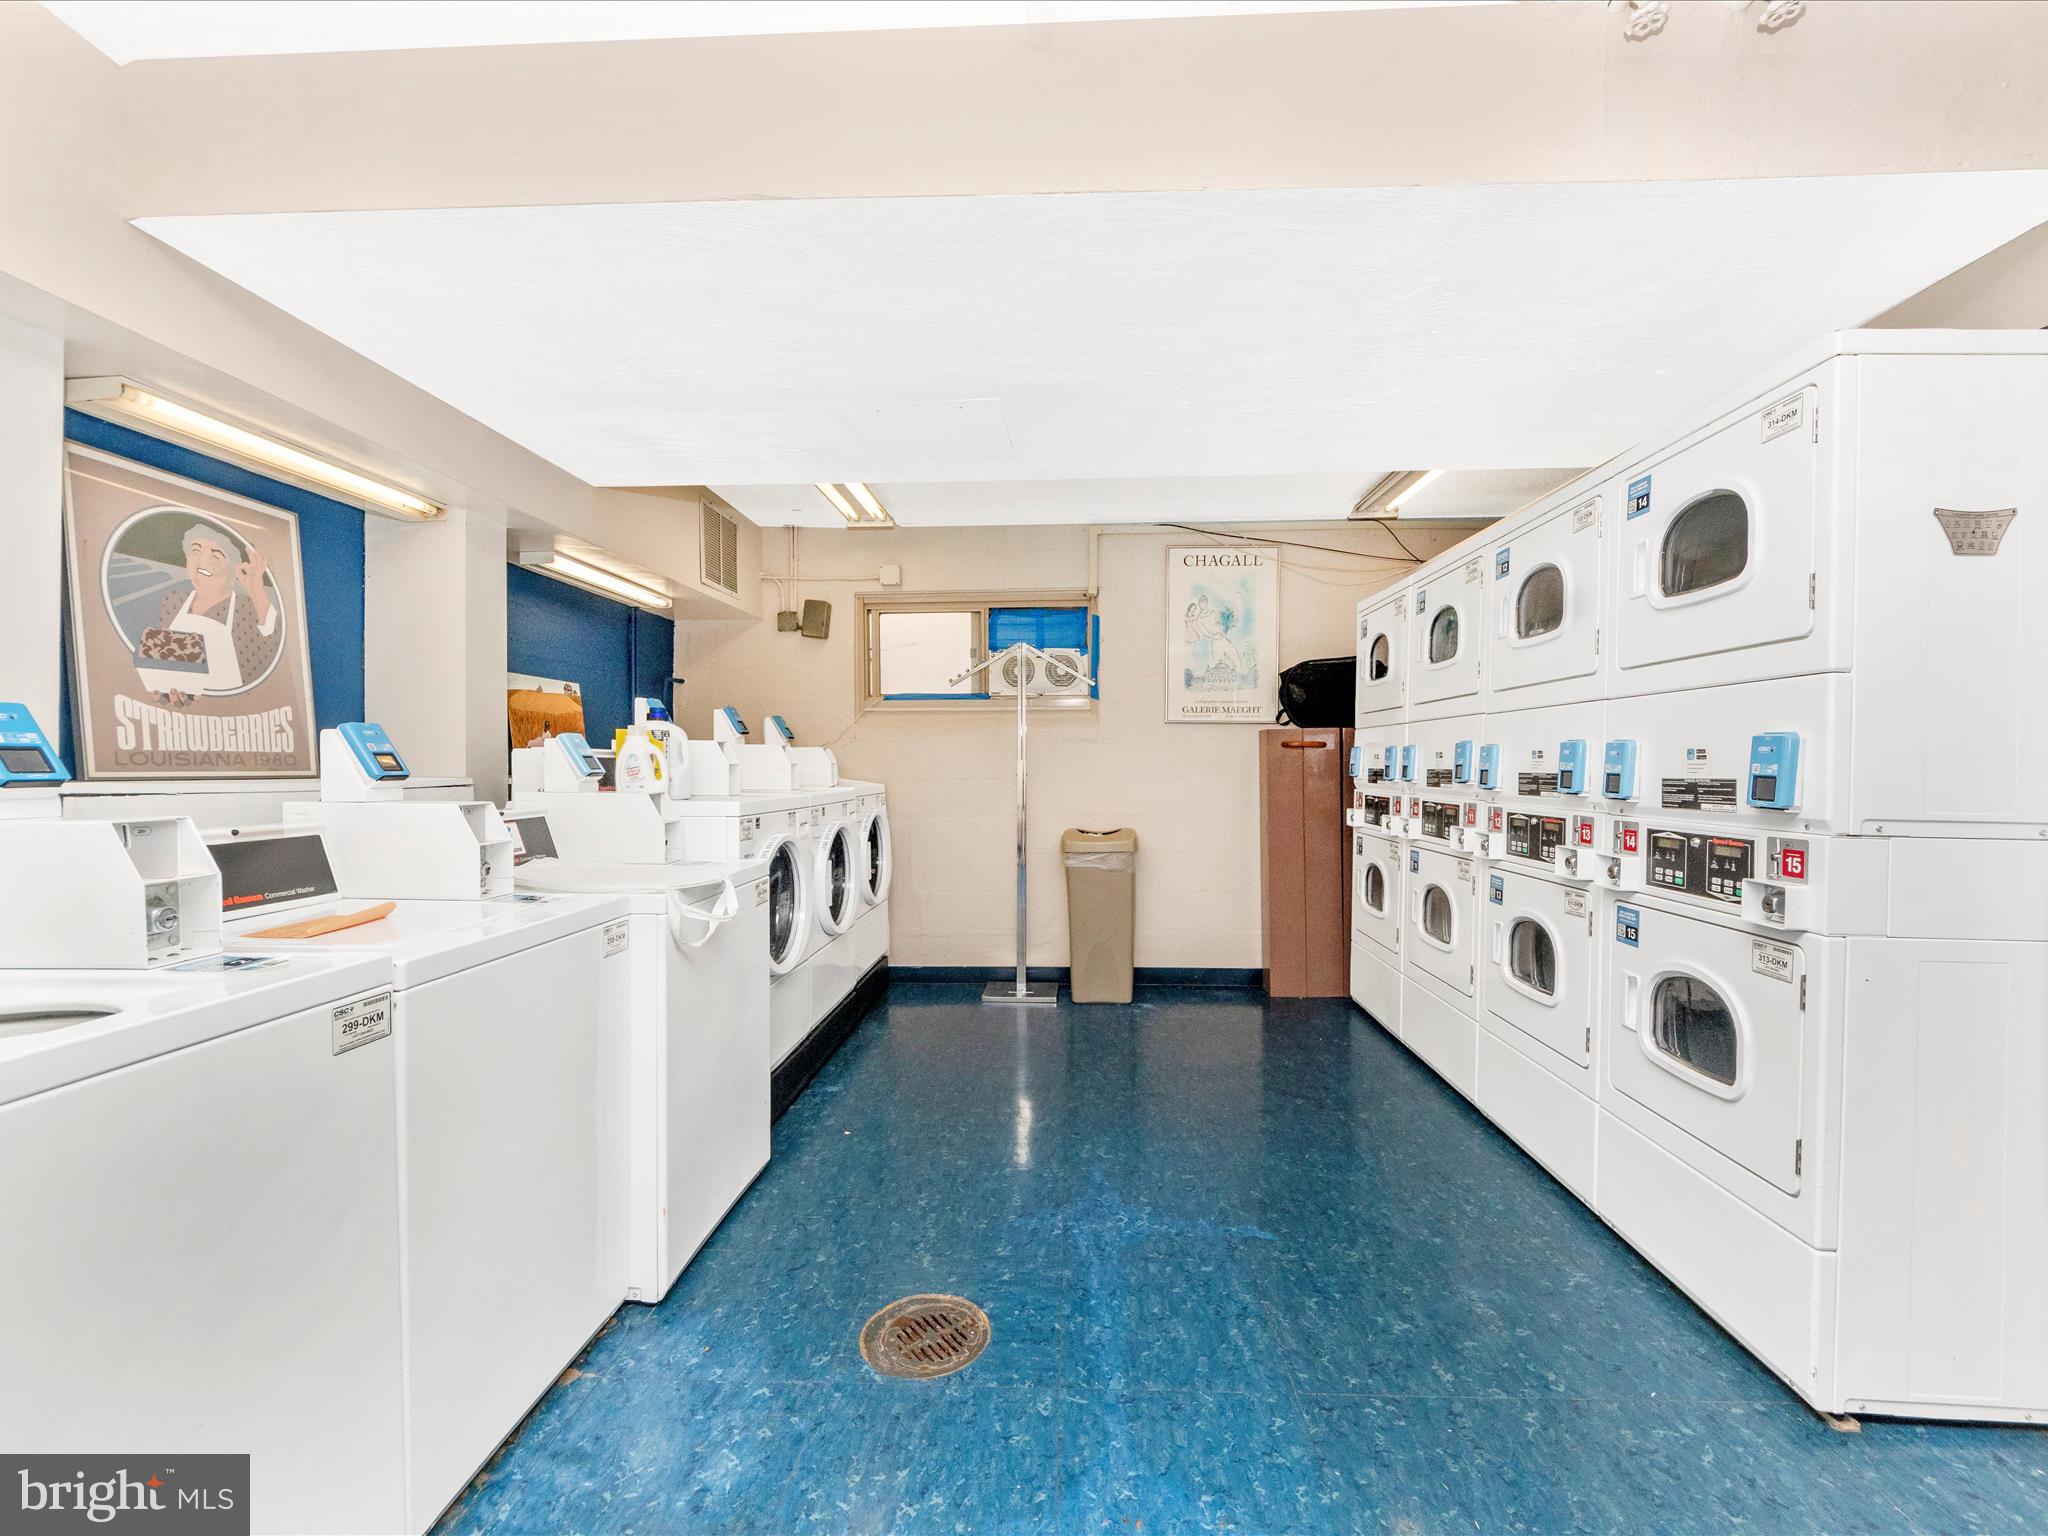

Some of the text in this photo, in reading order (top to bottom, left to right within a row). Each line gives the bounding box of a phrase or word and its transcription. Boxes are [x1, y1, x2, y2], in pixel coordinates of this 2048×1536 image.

[1767, 408, 1798, 429] 314-DKM
[1638, 495, 1648, 509] 14
[1183, 554, 1263, 567] CHAGALL
[1222, 706, 1261, 714] MAEGHT
[114, 694, 295, 753] STRAWBERRIES
[114, 752, 297, 767] LOUISIANA 1980
[1494, 817, 1502, 827] 12
[1582, 829, 1591, 840] 13
[1625, 836, 1636, 848] 14
[1785, 856, 1801, 873] 15
[264, 888, 296, 899] Commercial
[296, 886, 315, 894] Washer
[1627, 928, 1636, 939] 15
[1758, 953, 1788, 969] 313-DKM
[342, 1011, 384, 1034] 299-DKM
